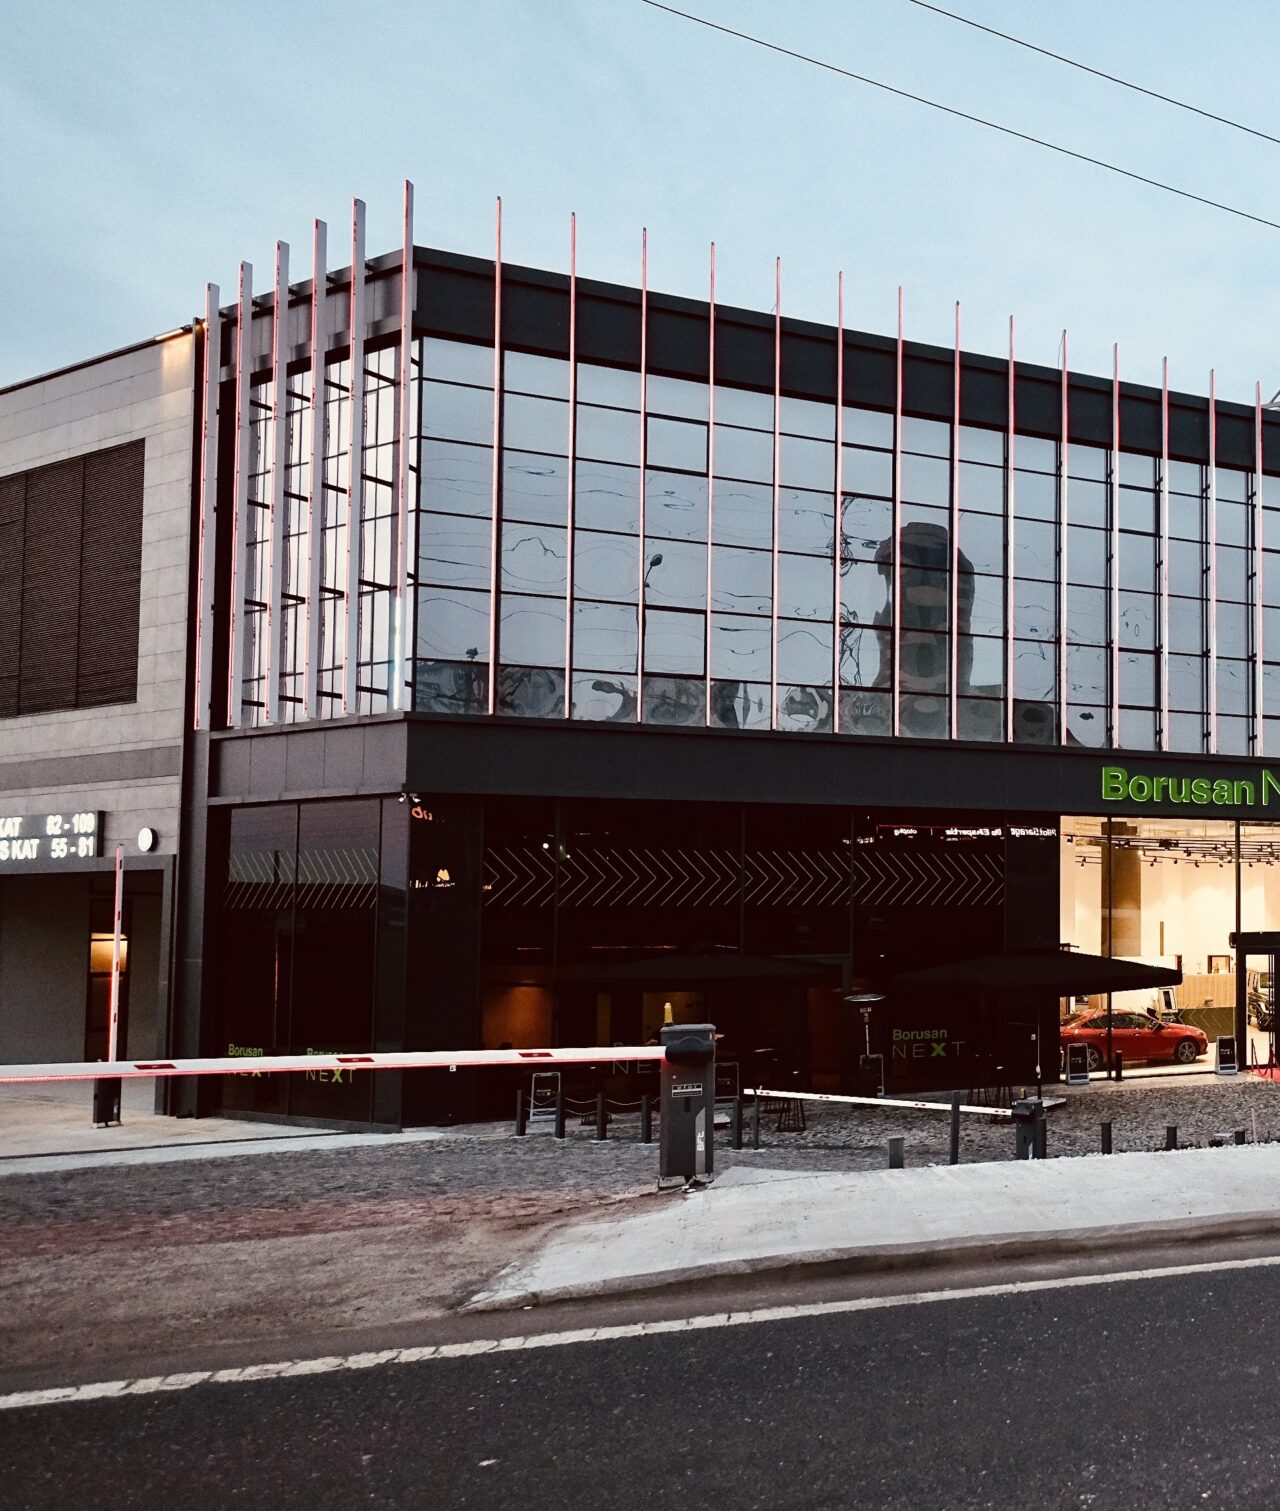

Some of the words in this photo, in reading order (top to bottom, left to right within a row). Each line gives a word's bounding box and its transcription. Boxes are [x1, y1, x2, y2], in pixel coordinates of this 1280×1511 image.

[1101, 766, 1254, 805] Borusan
[12, 838, 40, 859] KAT
[892, 1028, 947, 1041] Borusan
[228, 1043, 263, 1057] Borusan
[892, 1041, 966, 1059] NEXT
